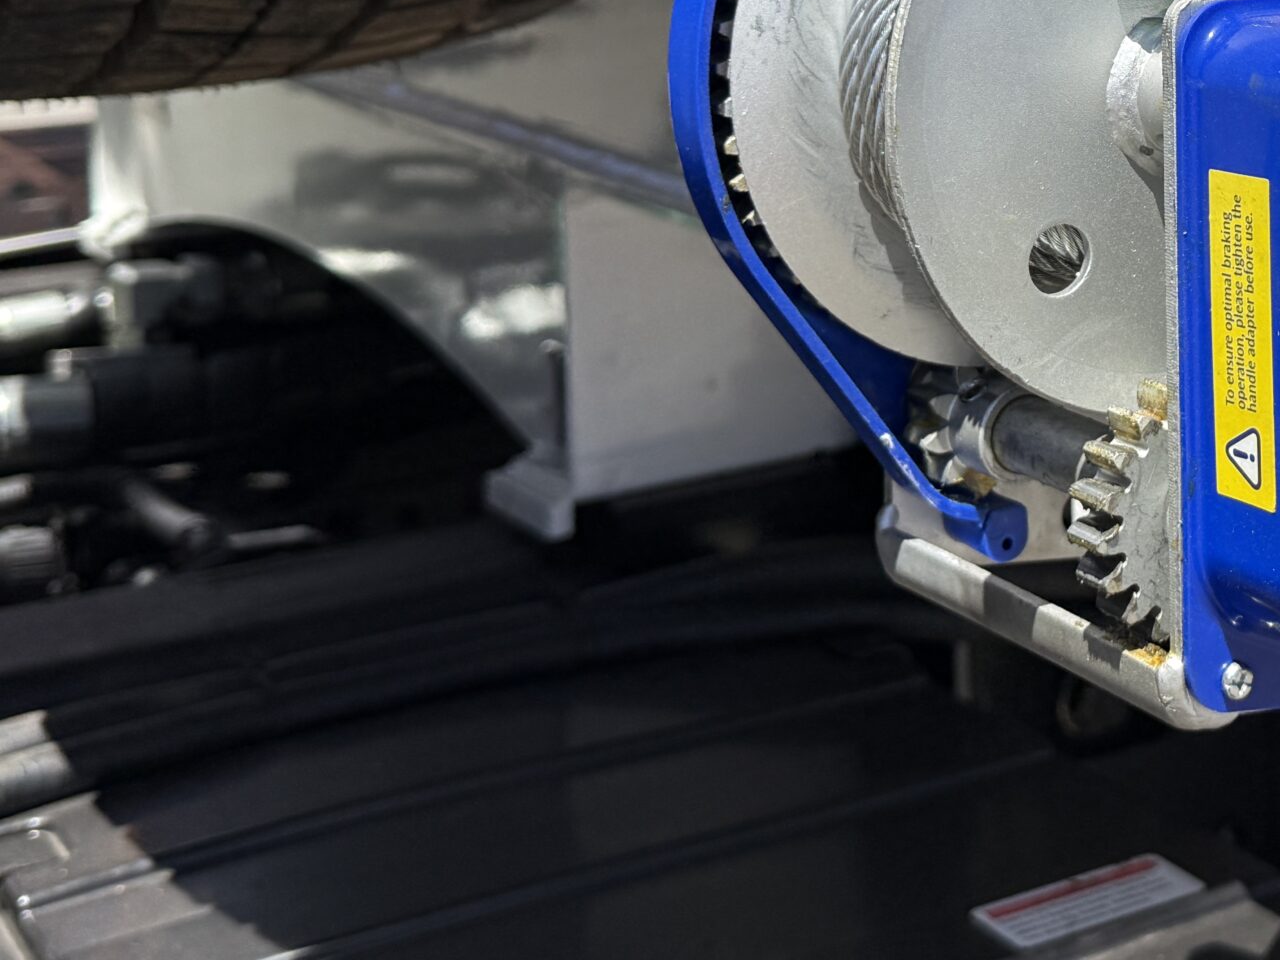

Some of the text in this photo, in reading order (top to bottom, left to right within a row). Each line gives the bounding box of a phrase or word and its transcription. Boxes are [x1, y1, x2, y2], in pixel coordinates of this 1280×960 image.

[1221, 212, 1235, 406] To ensure optimal braking
[1231, 194, 1248, 410] operation, please tighten the
[1244, 212, 1257, 413] handle adapter before use.
